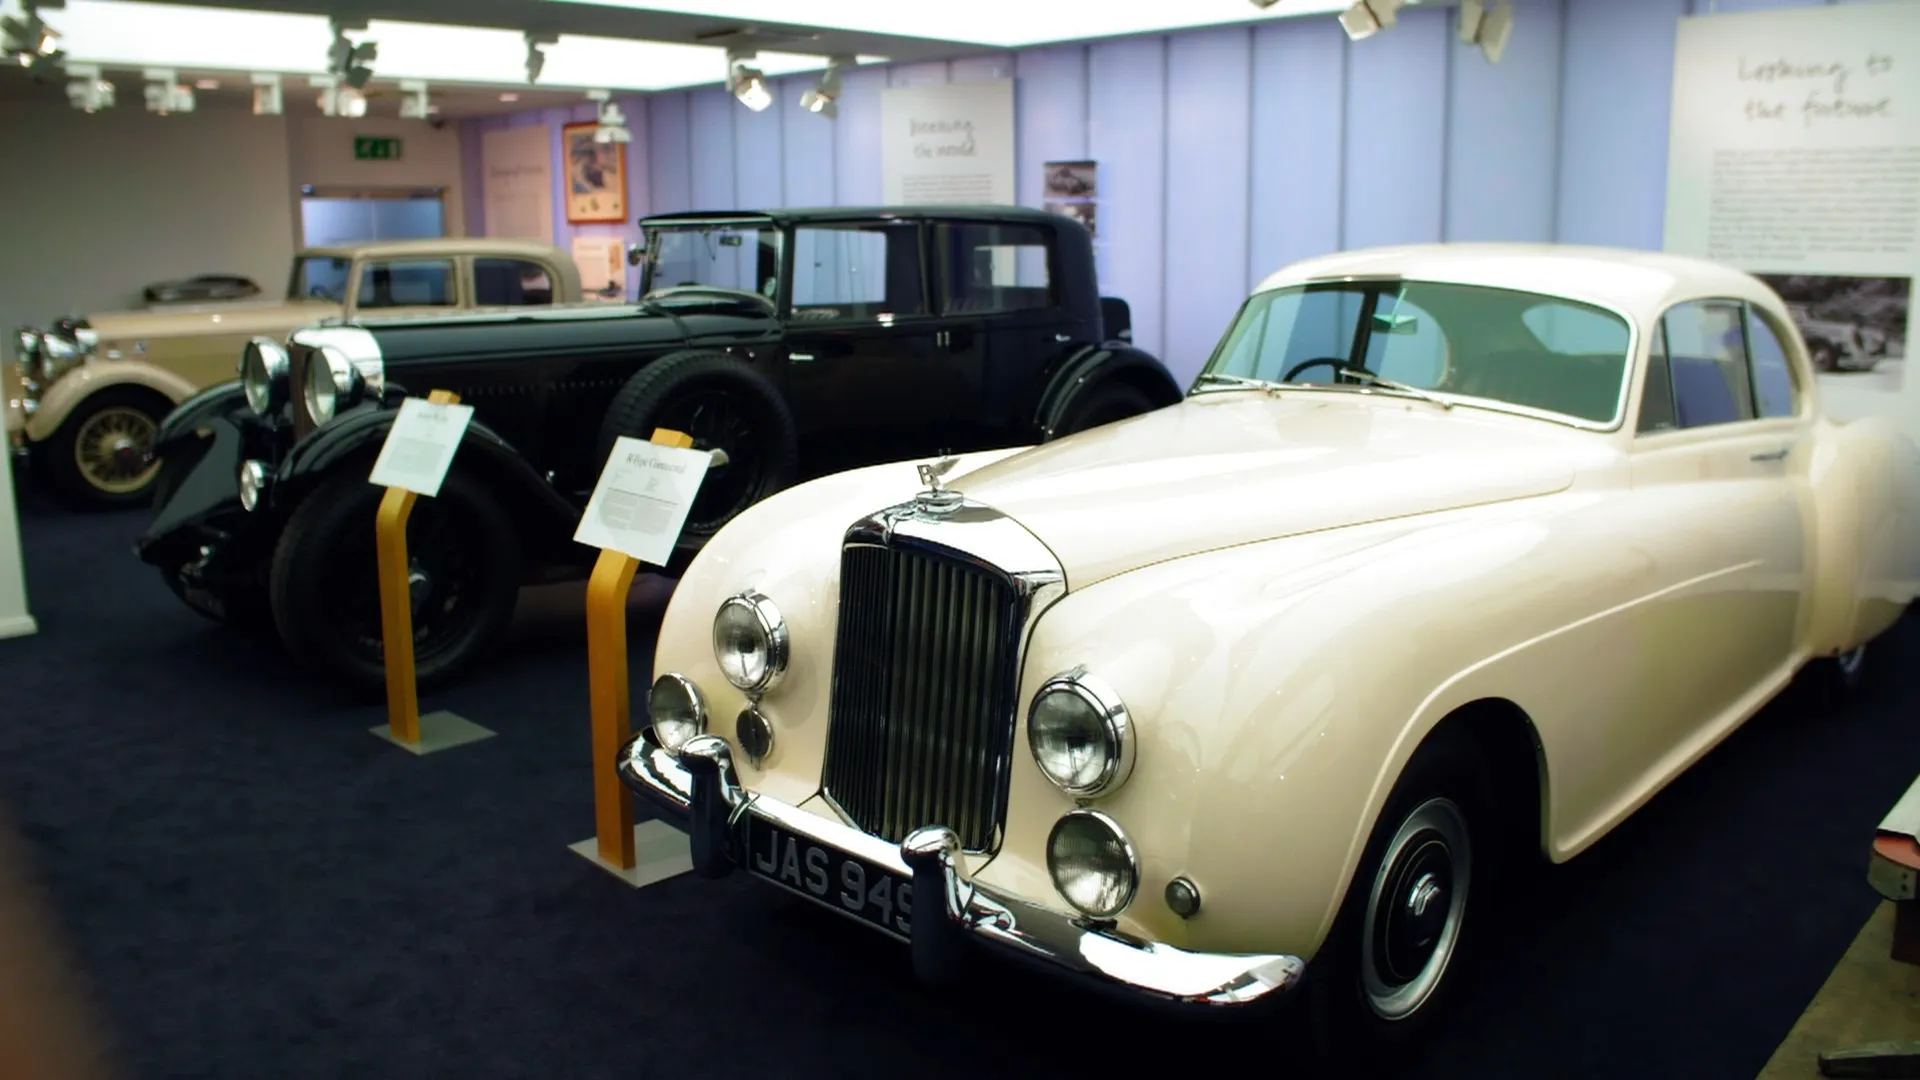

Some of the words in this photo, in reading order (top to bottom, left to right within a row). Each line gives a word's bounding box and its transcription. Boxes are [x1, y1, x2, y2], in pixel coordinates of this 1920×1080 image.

[1737, 55, 1851, 95] Looking
[1865, 51, 1895, 77] to
[1744, 98, 1786, 120] the
[1802, 90, 1893, 128] future
[756, 830, 830, 896] JAS
[840, 860, 914, 935] 949
